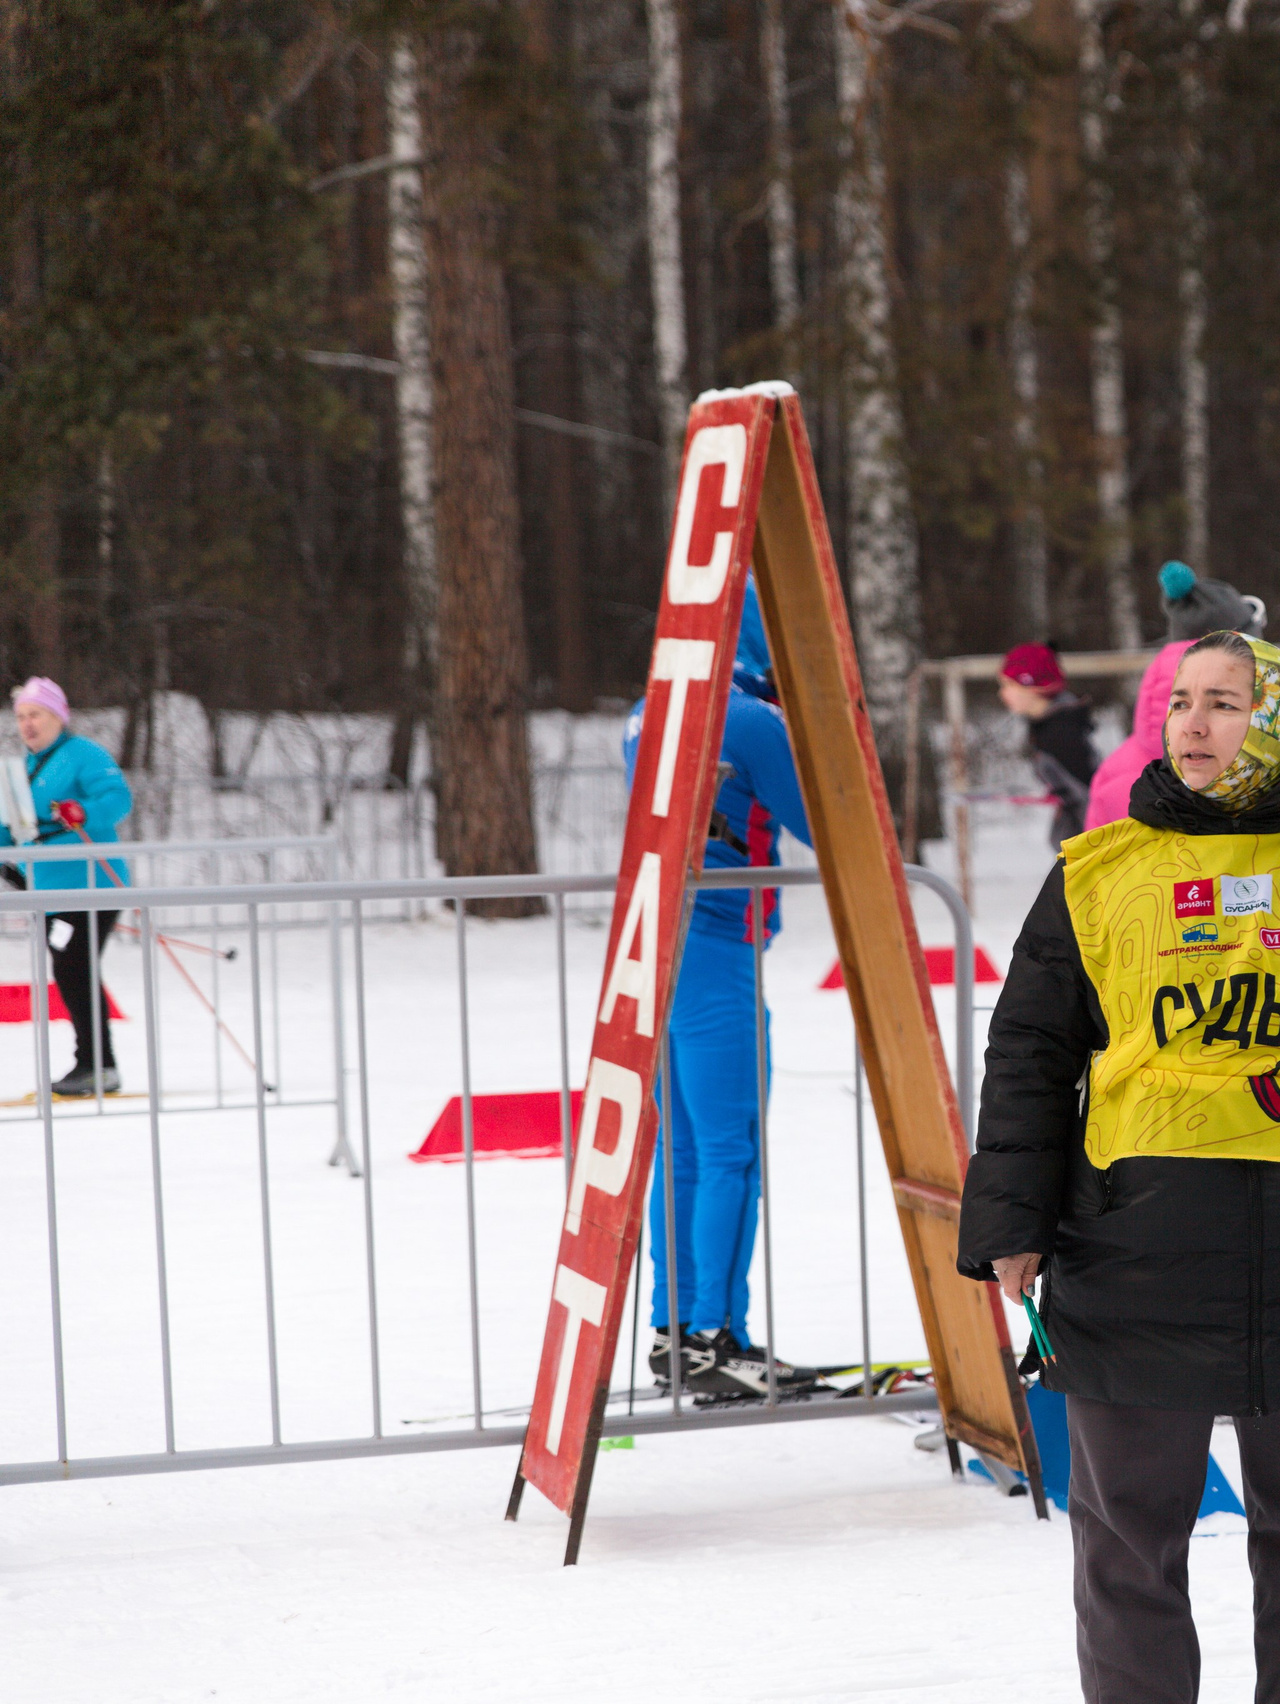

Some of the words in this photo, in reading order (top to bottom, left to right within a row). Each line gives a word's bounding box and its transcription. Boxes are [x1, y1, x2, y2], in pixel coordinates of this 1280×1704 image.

[1224, 901, 1270, 913] СУСАНИН
[545, 423, 747, 1457] СТАРТ
[1157, 942, 1245, 957] ЧЕЛТРАНСХОЛДИНГ
